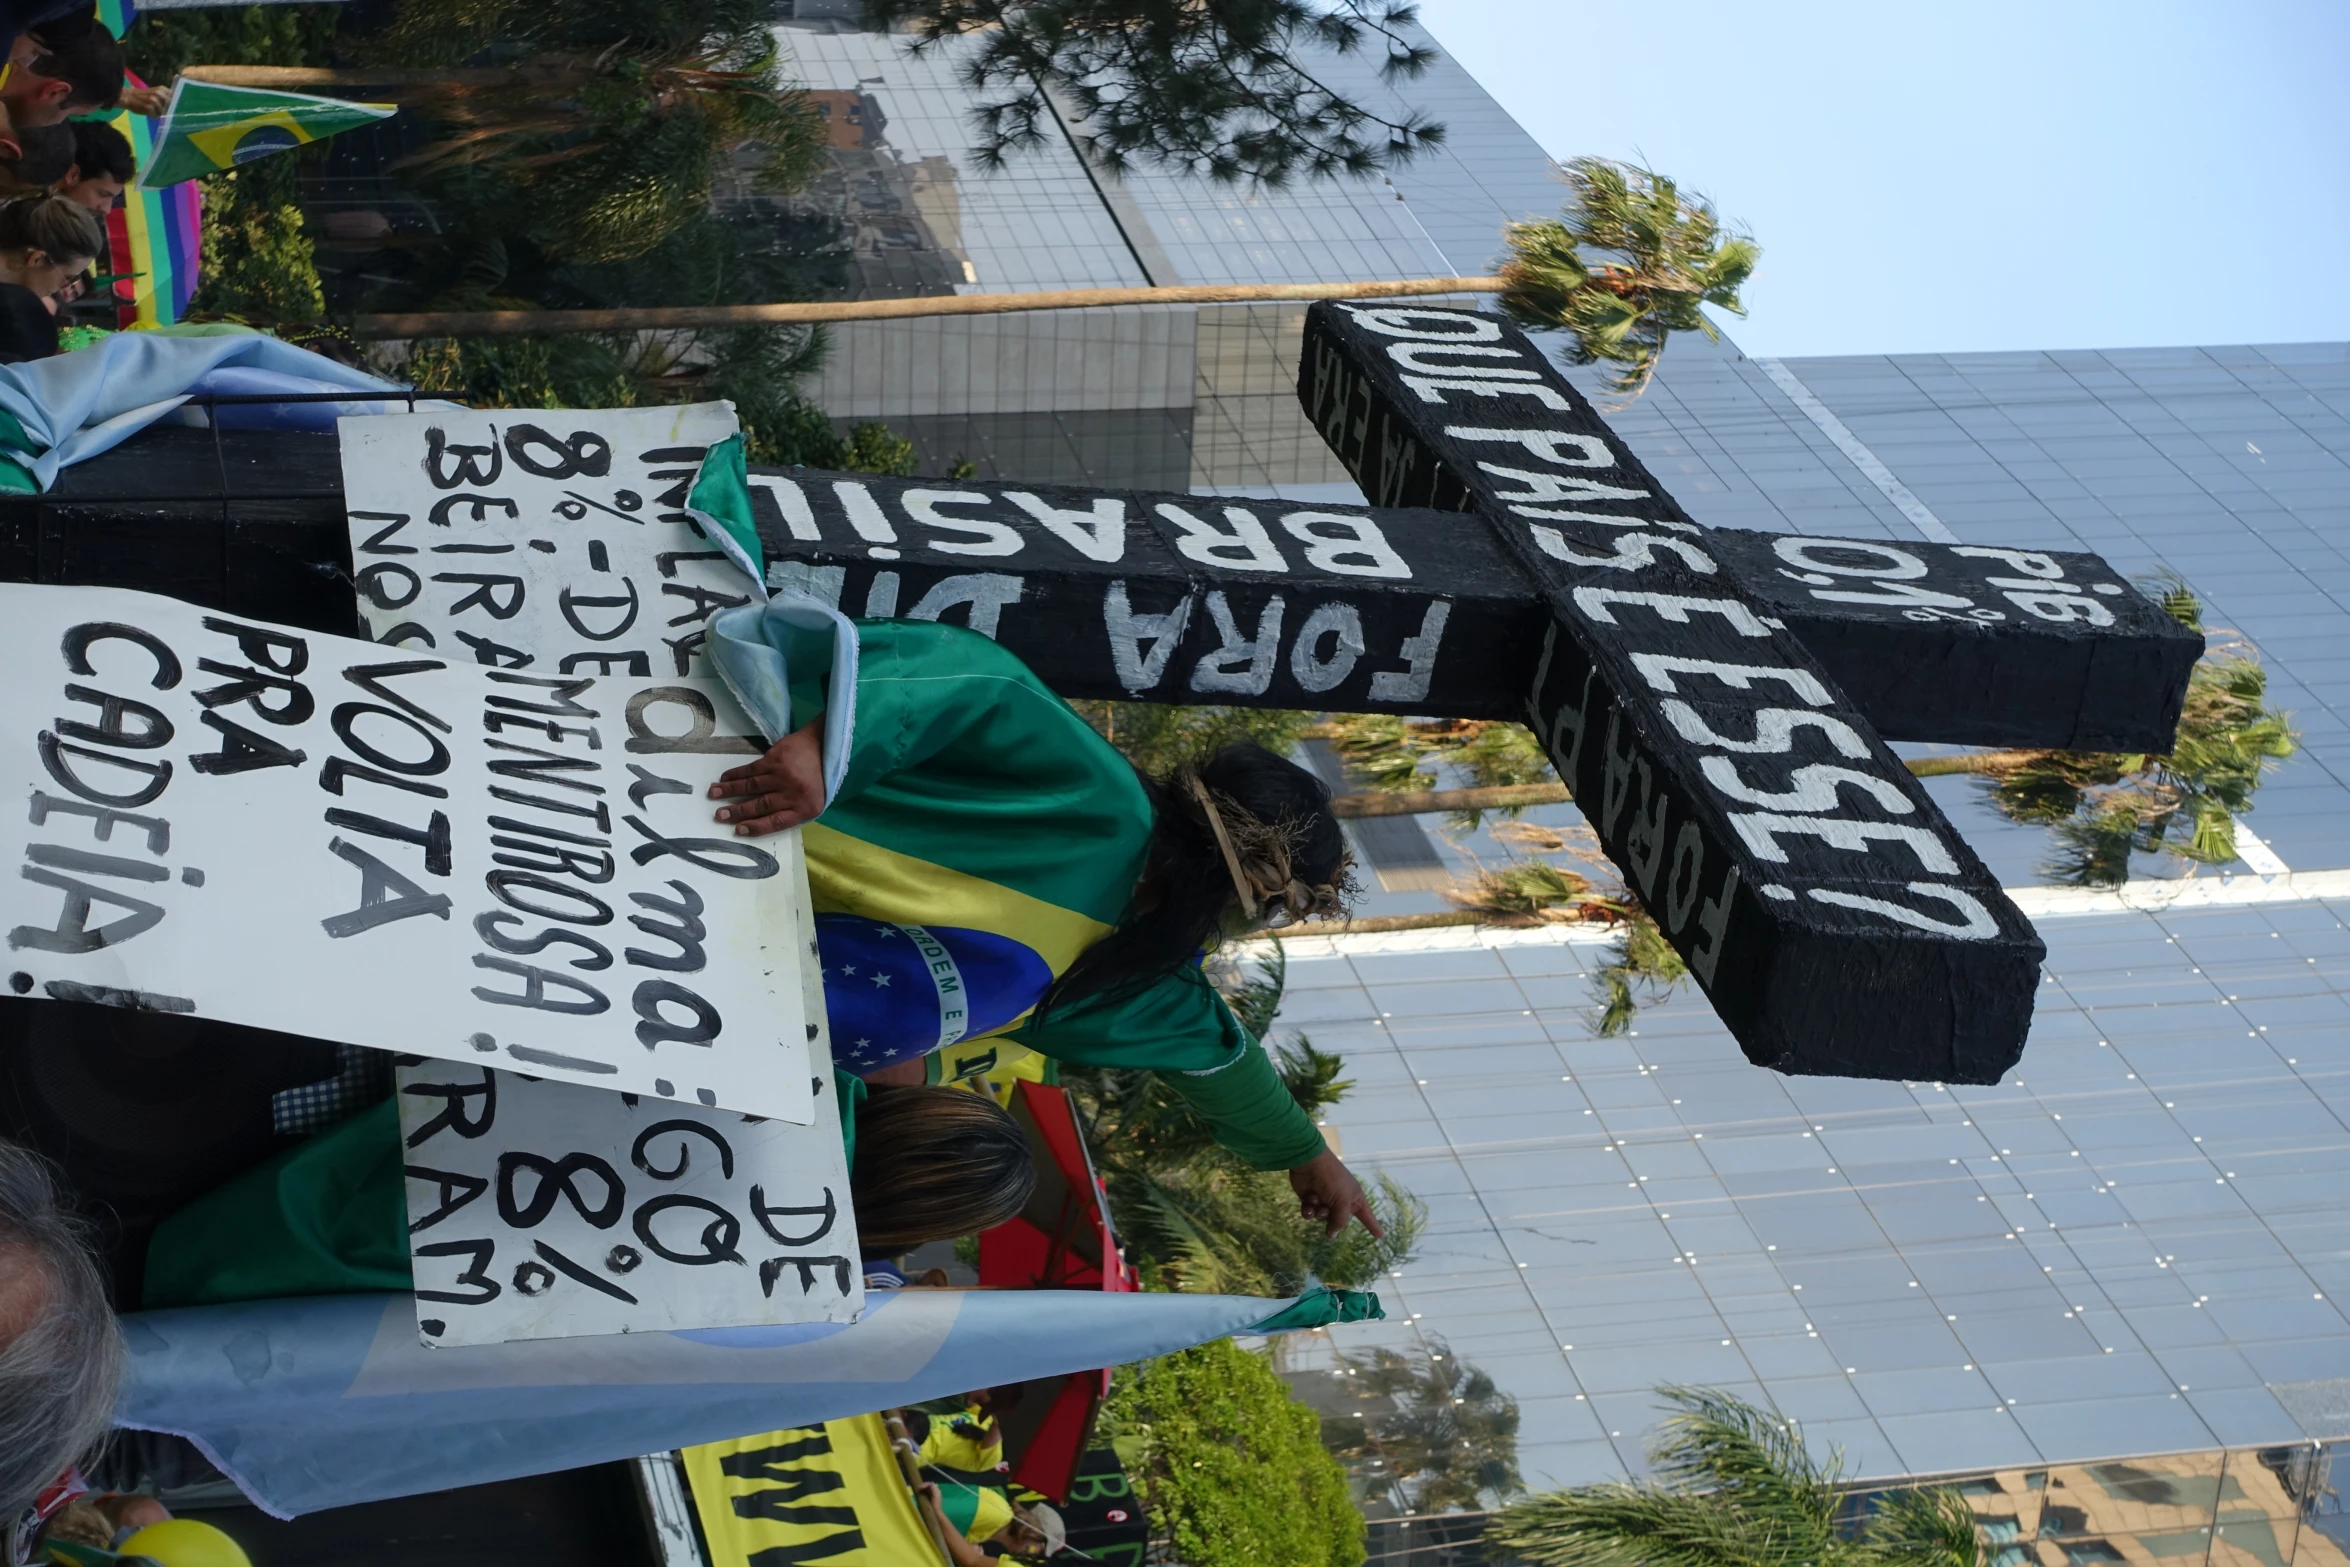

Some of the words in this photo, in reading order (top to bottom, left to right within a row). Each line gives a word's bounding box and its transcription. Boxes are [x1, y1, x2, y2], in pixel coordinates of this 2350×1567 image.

[1312, 334, 1372, 488] ERA
[1334, 304, 1571, 411] QUE
[1102, 581, 1452, 702] FORA
[1572, 586, 1789, 638] É
[189, 615, 316, 776] PRA
[1524, 620, 1597, 801] PT
[318, 659, 454, 939] VOLTA
[469, 671, 620, 1076] MENTIROSA!
[1601, 708, 1741, 991] FORA
[1628, 653, 1999, 940] ESSE?
[904, 928, 960, 994] ORDEM
[944, 1010, 963, 1021] E
[393, 1049, 502, 1338] RAM.
[496, 1151, 644, 1307] 8%
[621, 1092, 748, 1267] GO
[749, 1184, 852, 1298] DE
